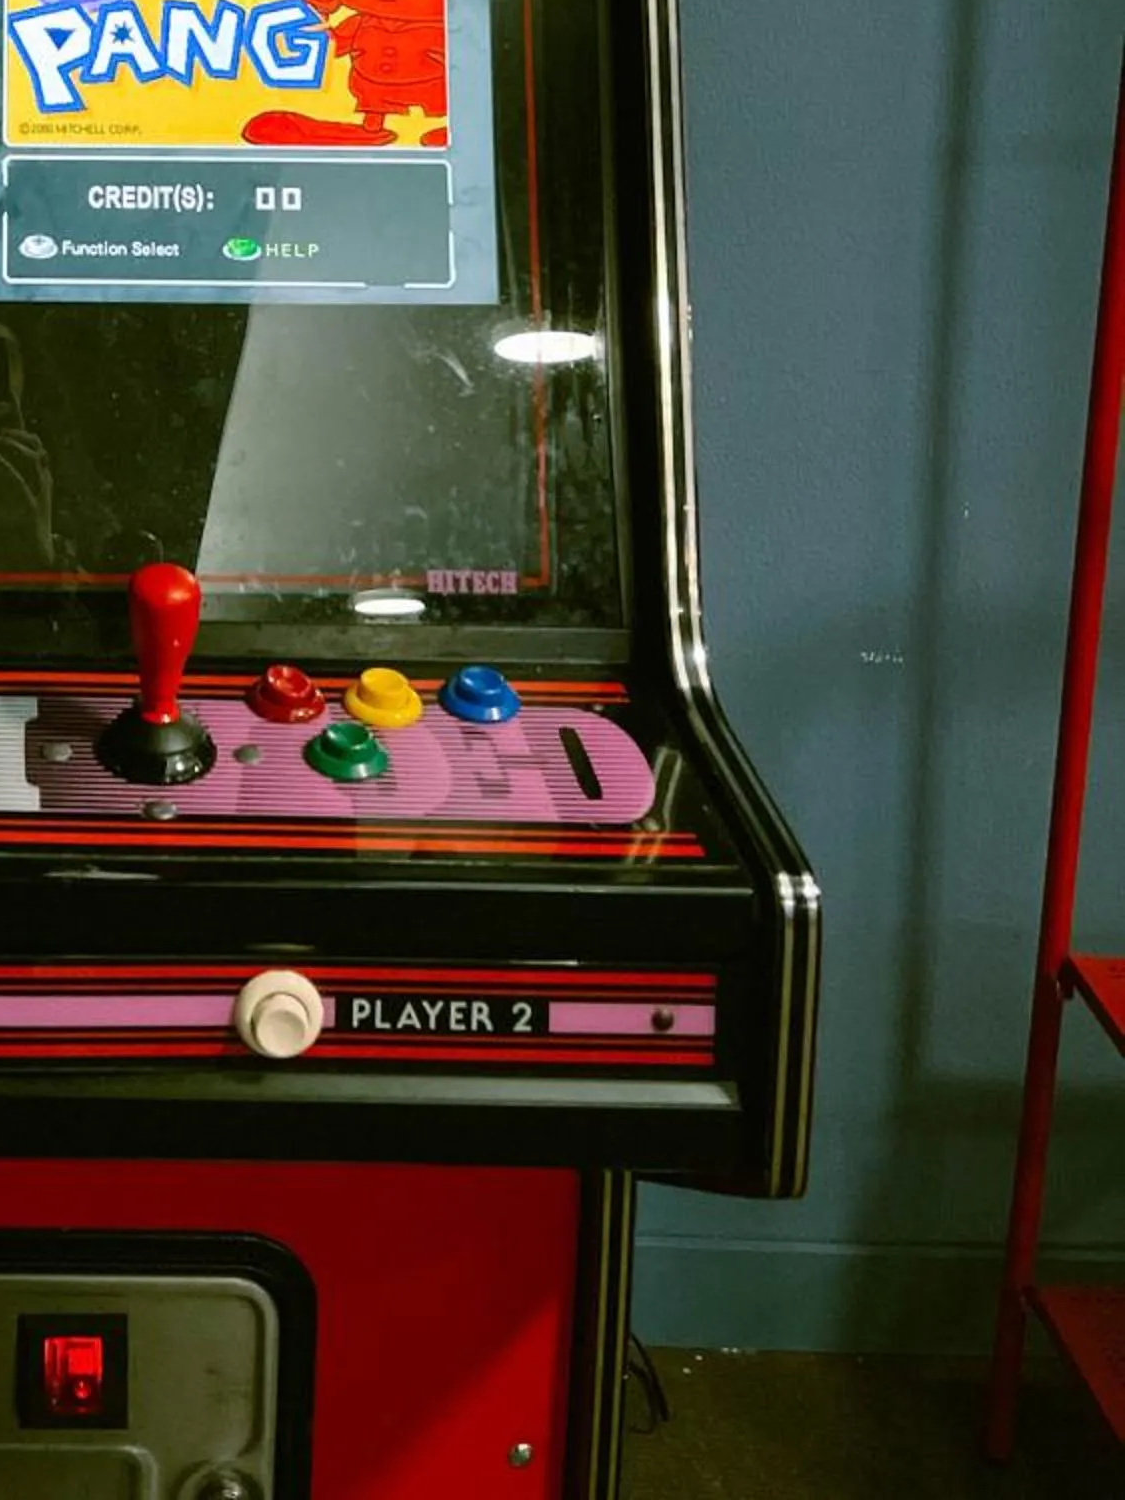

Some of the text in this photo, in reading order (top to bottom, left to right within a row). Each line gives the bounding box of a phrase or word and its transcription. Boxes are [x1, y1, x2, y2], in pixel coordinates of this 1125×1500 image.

[8, 0, 329, 112] PANG
[88, 185, 215, 211] CREDIT(S):
[62, 241, 180, 257] Function Select
[266, 243, 319, 258] HELP
[426, 569, 518, 595] HITECH
[351, 998, 532, 1032] PLAYER 2
